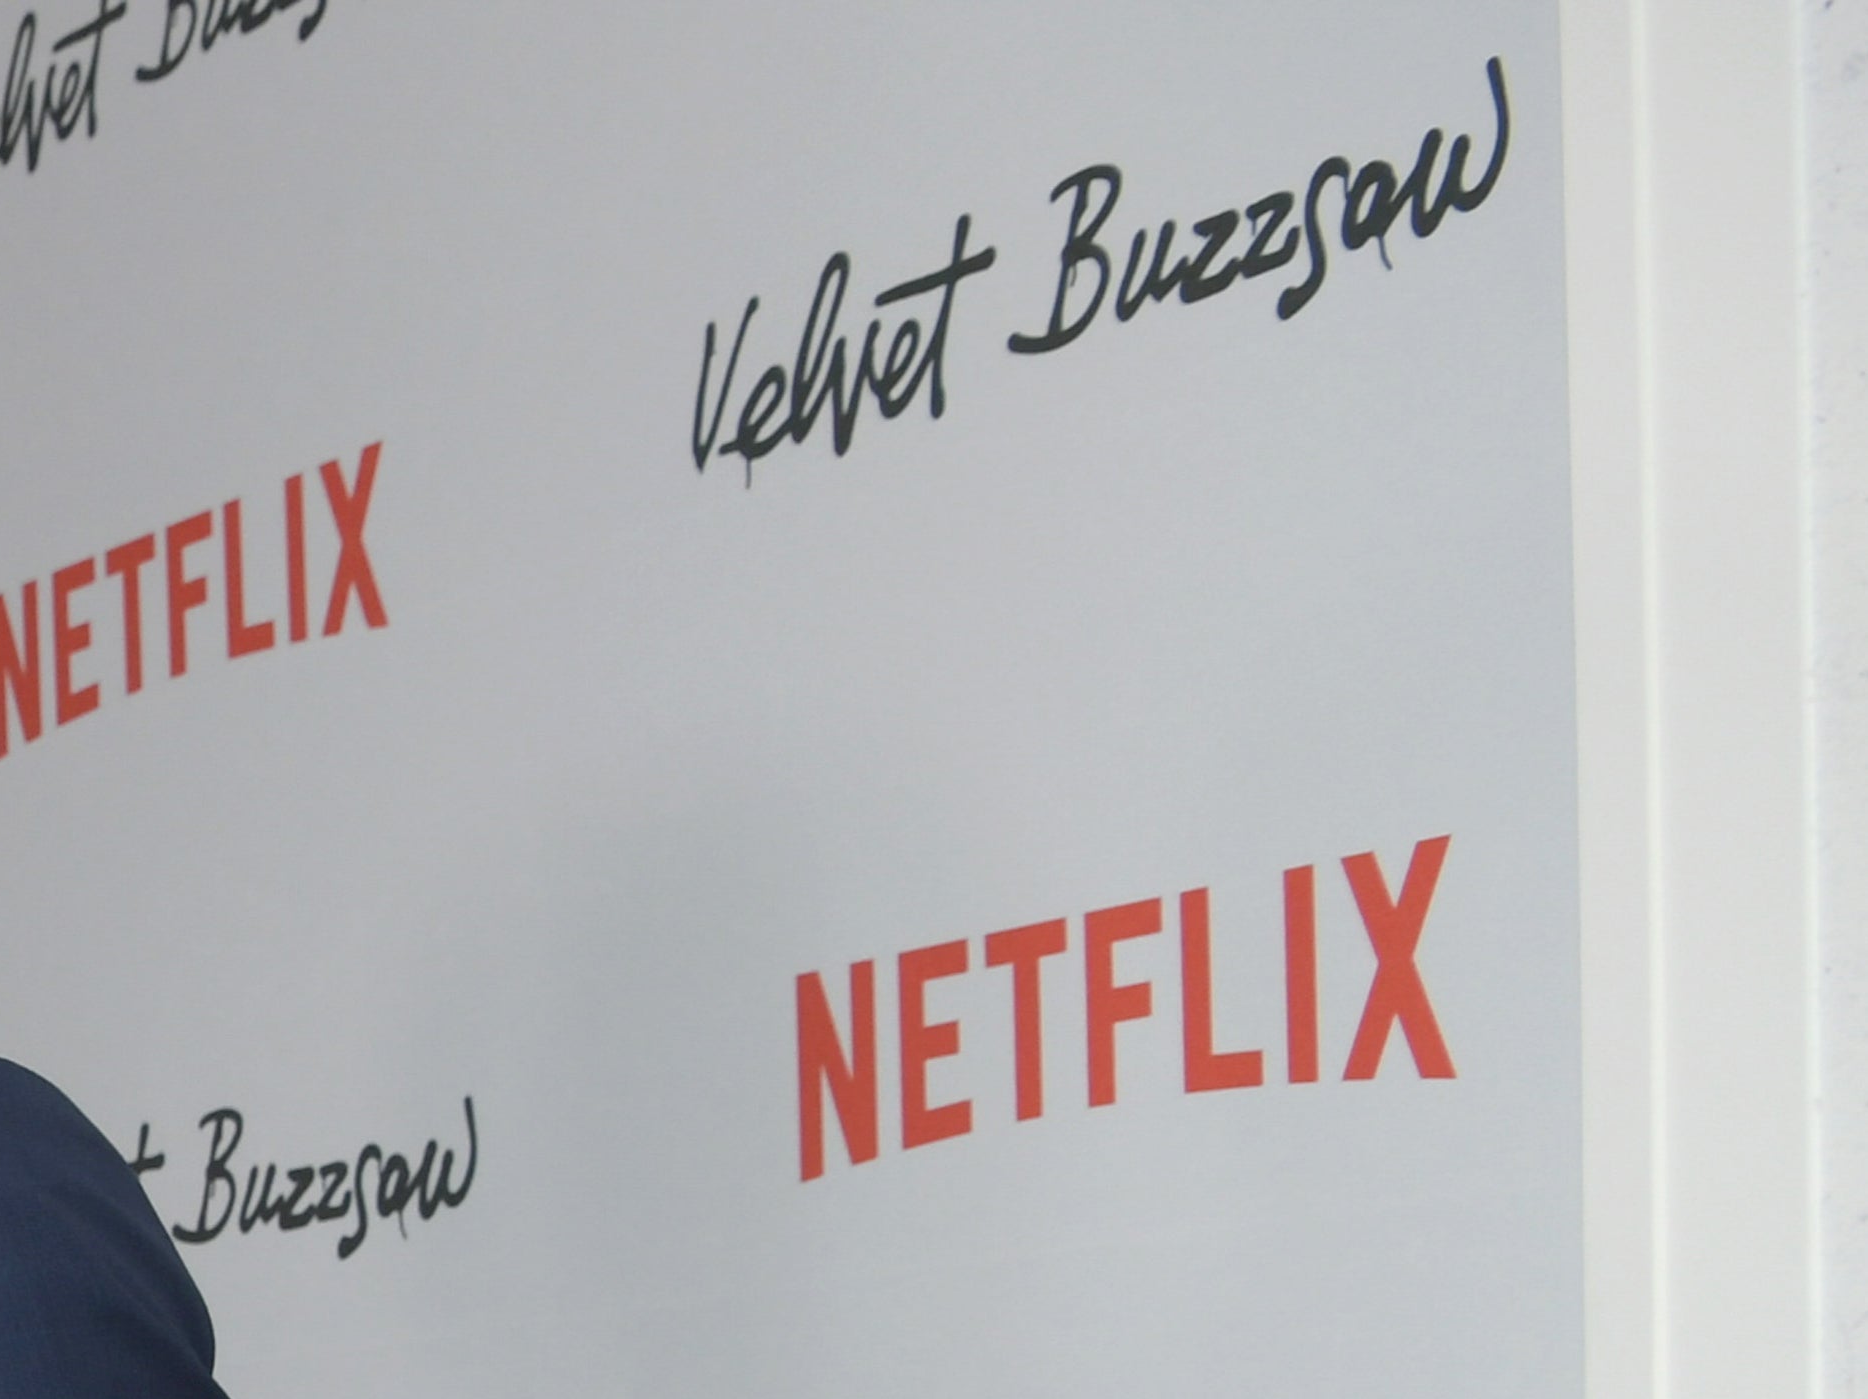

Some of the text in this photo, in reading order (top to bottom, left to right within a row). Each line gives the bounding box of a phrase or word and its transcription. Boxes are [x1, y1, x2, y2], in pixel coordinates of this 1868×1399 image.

[690, 56, 1511, 480] Velvet Buzzsaw
[171, 1095, 479, 1260] Buzzsaw
[795, 833, 1458, 1183] NETFLIX
